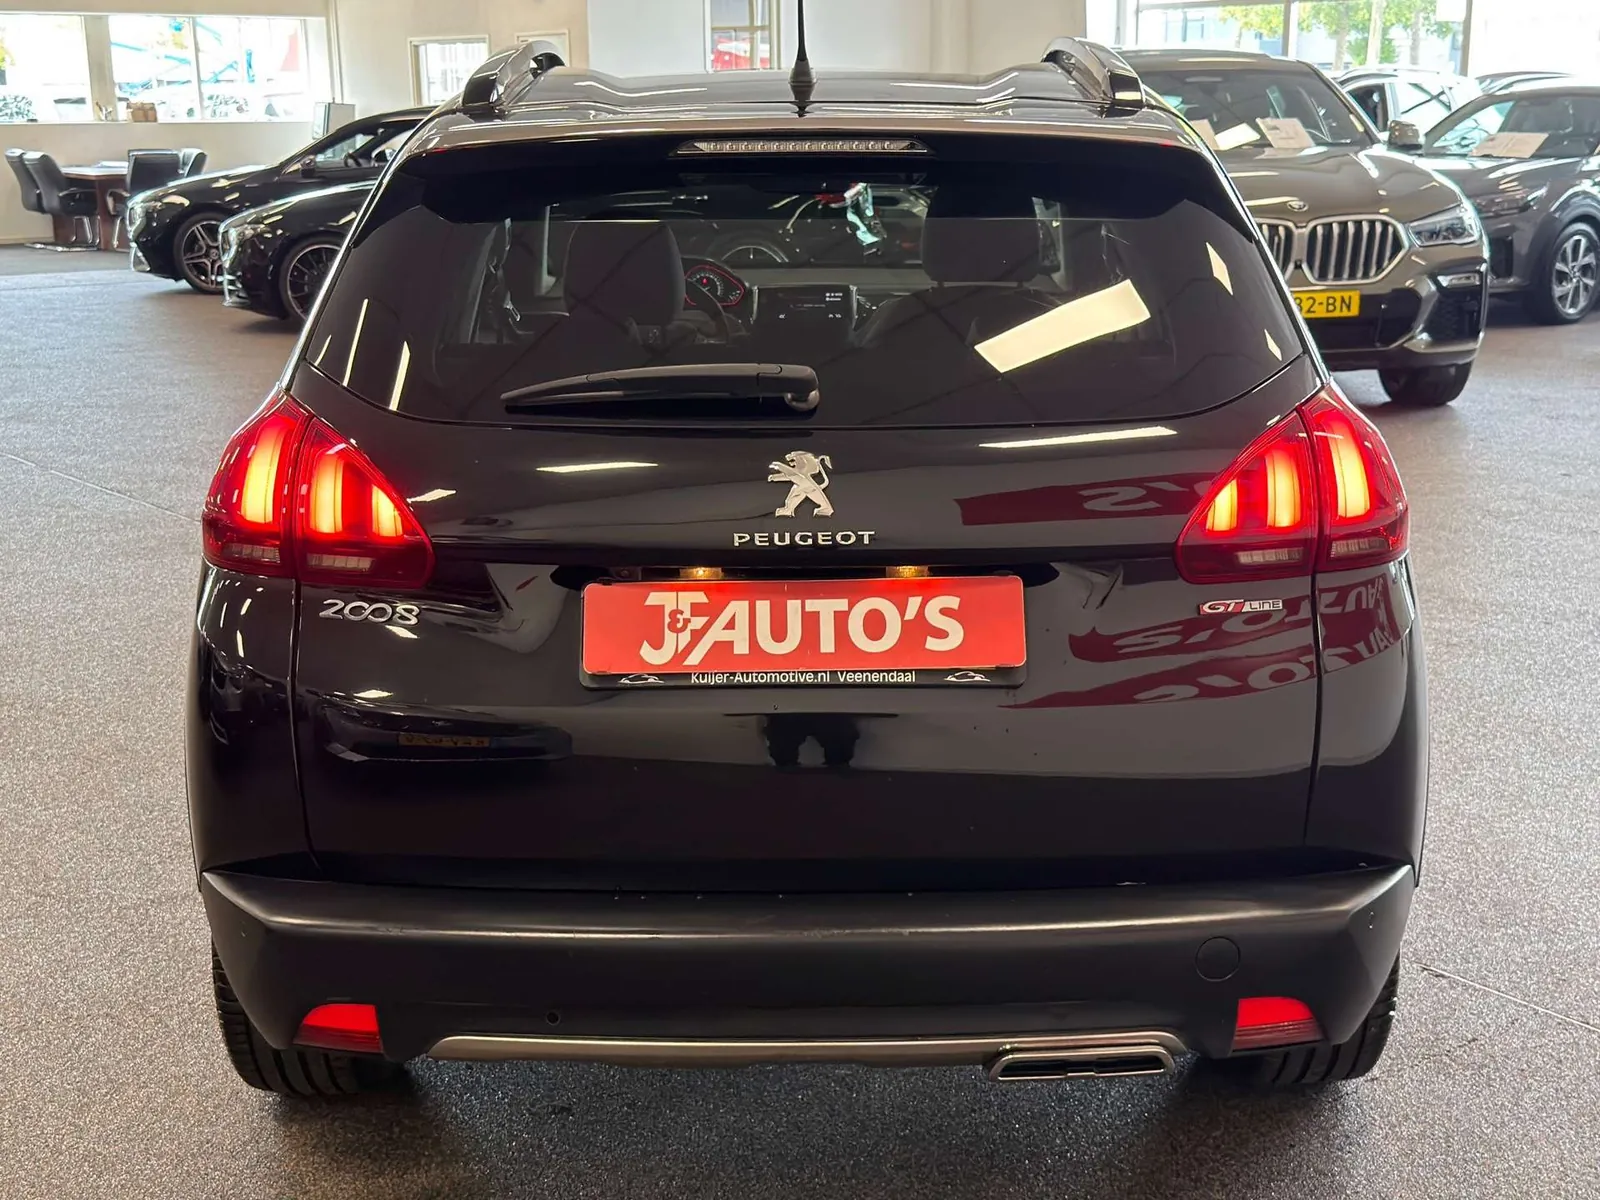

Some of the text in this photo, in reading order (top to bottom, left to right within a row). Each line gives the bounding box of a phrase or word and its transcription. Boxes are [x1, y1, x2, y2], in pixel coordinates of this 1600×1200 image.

[733, 531, 876, 547] PEUGEOT
[319, 599, 420, 625] 2008
[1202, 599, 1282, 613] GT LINE
[690, 670, 916, 686] Kuijer-Automotive.nl Veenendaal
